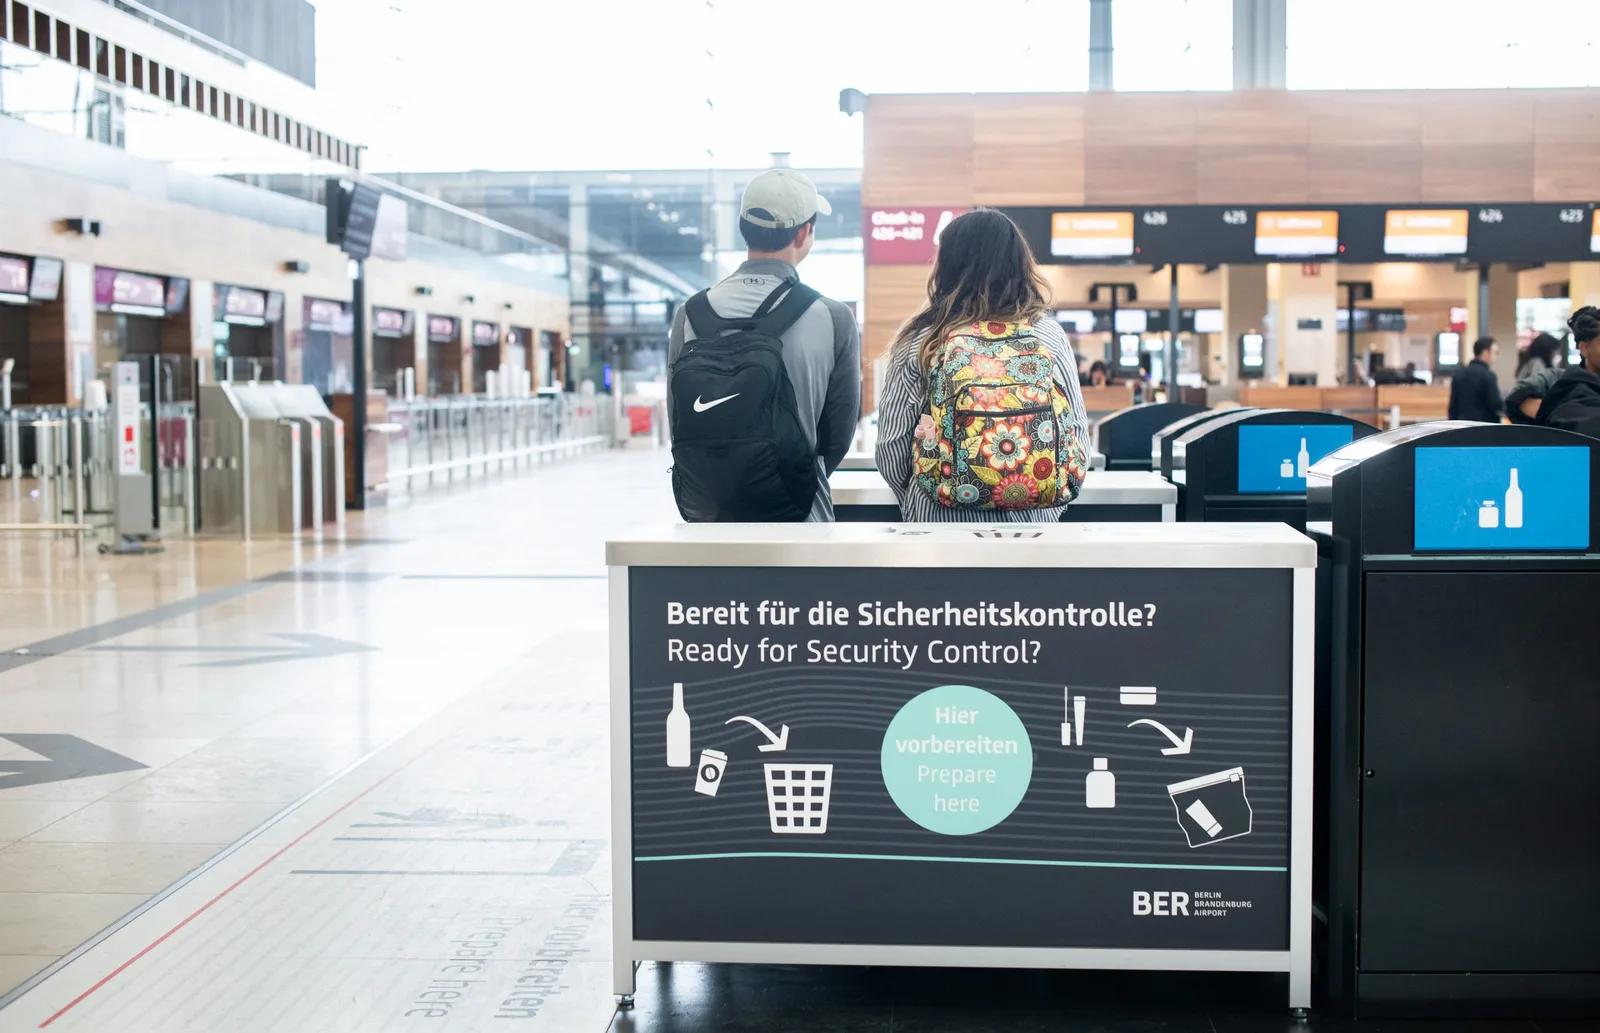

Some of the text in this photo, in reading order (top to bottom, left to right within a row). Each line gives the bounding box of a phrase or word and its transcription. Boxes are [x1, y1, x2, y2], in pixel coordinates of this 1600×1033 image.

[667, 600, 1157, 627] Bereit für die Sicherheitskontrolle?
[668, 637, 1041, 670] Ready for Security Control?
[935, 706, 979, 724] Hier
[895, 735, 1018, 754] vorbereiten
[918, 765, 997, 787] Prepare
[934, 793, 980, 812] here
[1132, 891, 1190, 916] BER
[1194, 891, 1222, 899] BERLIN
[1194, 900, 1252, 908] BRANDENBURG
[404, 916, 531, 1018] Prepare here
